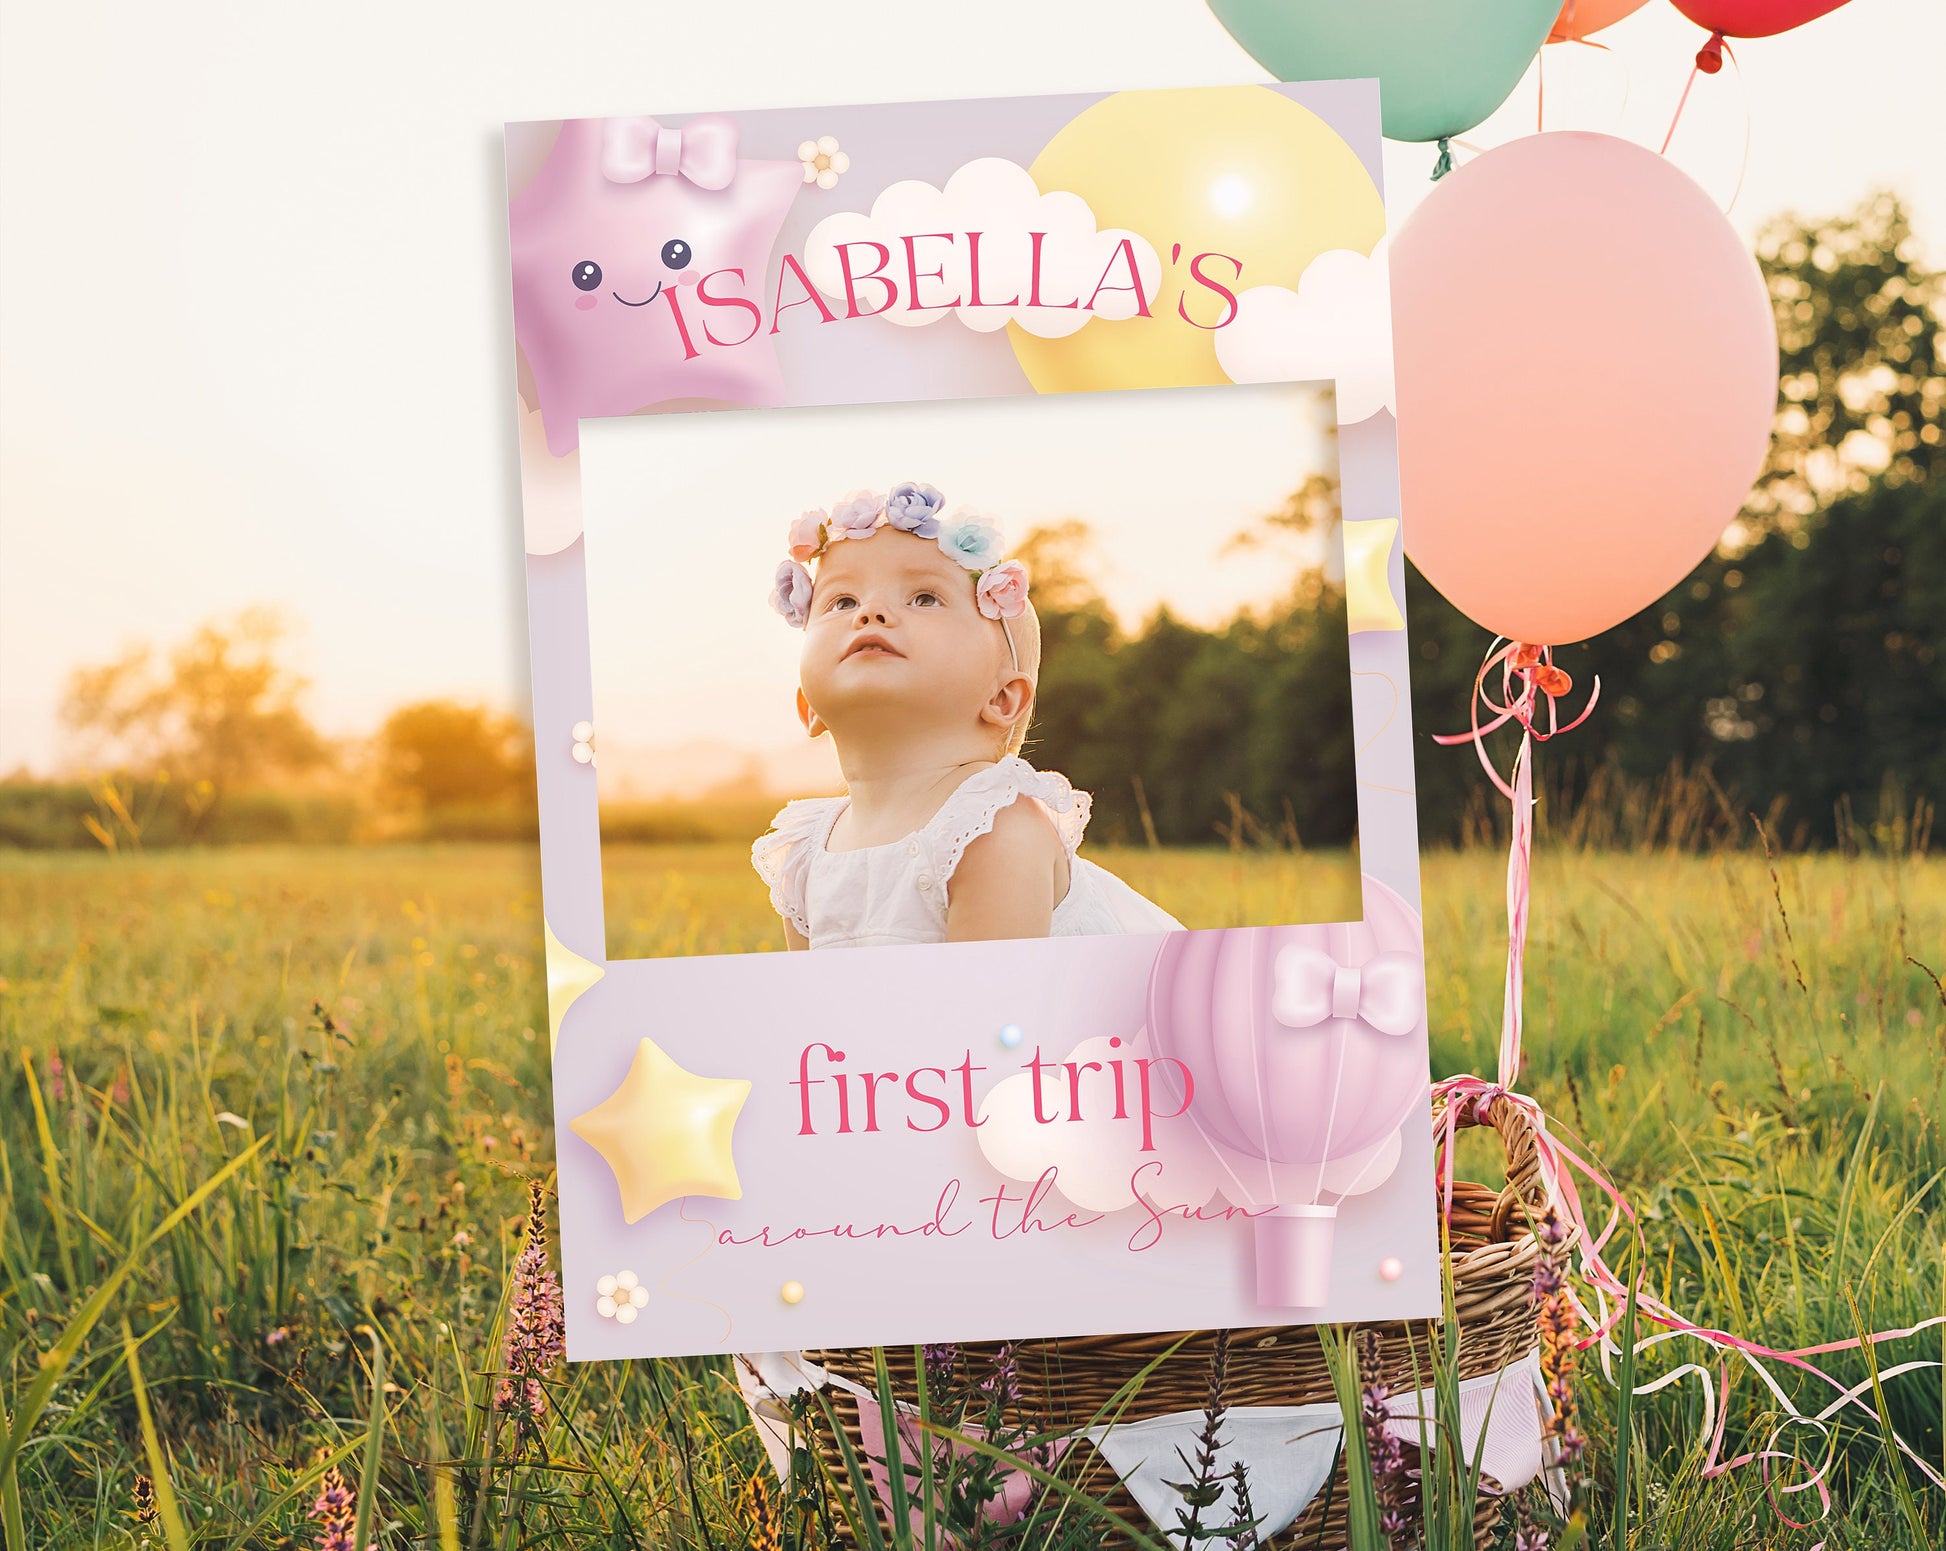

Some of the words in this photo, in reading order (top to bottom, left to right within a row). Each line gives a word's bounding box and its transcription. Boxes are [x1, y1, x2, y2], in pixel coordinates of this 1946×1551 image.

[660, 231, 1243, 361] ISABELLA'S
[788, 1043, 988, 1136] first
[1021, 1036, 1195, 1152] trip
[718, 1179, 972, 1248] around
[979, 1166, 1105, 1241] the
[1127, 1161, 1280, 1252] Sun
